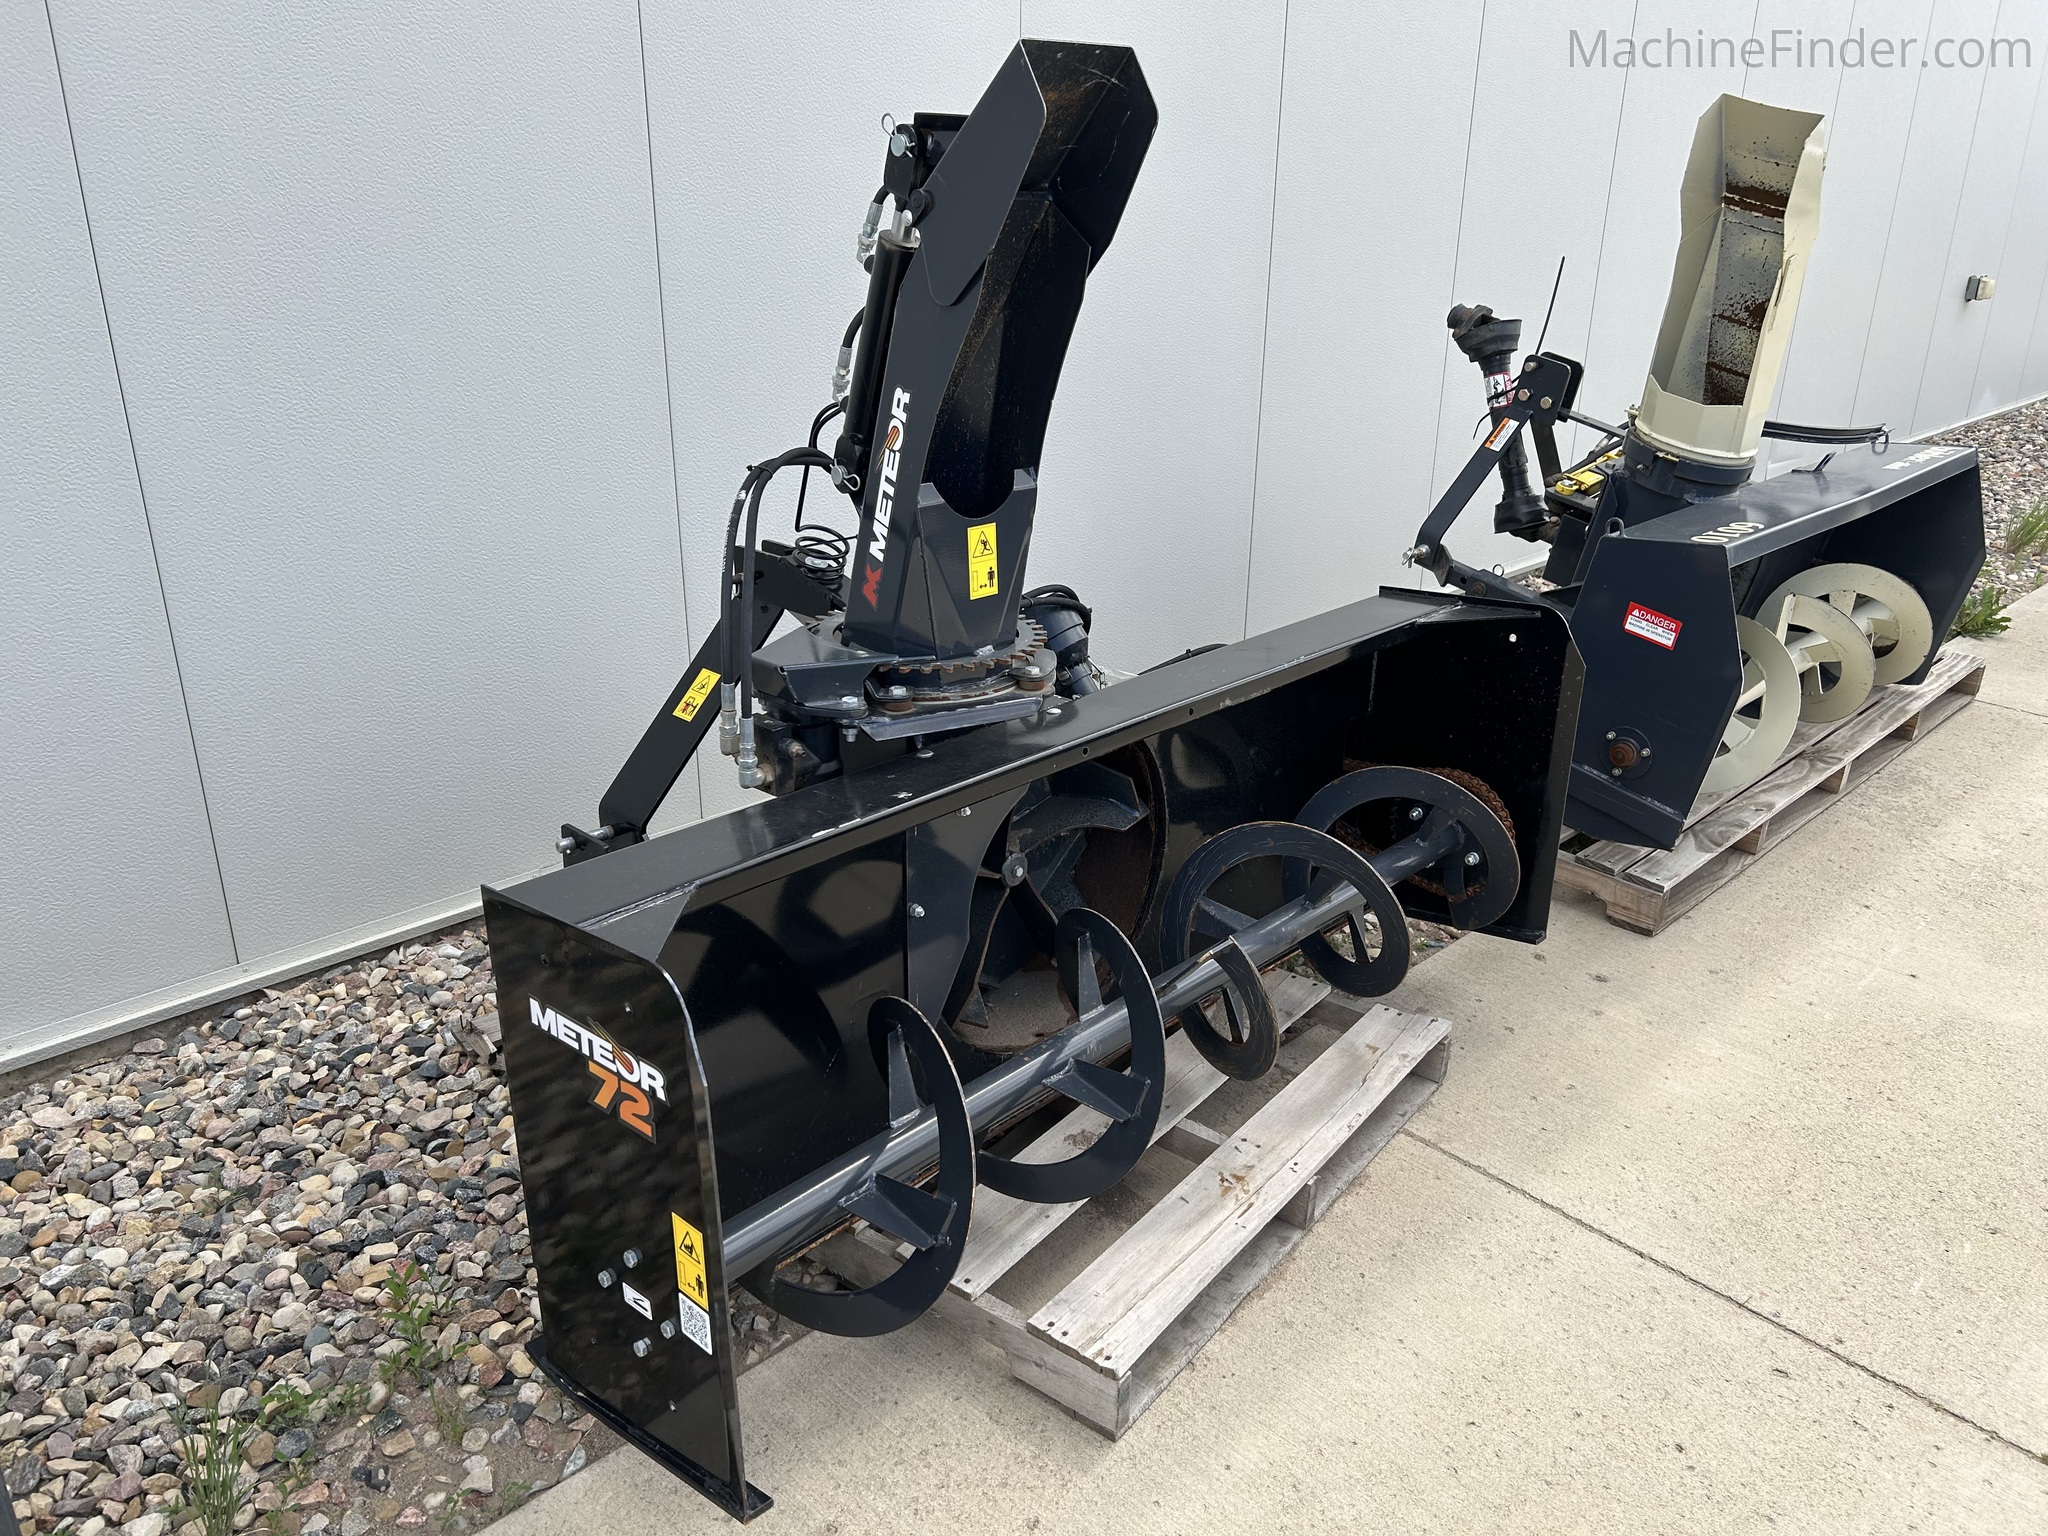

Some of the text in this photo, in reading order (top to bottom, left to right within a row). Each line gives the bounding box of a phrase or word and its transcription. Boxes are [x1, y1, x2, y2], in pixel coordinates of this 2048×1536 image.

[869, 387, 911, 563] METEOR
[1690, 521, 1765, 543] 6010
[1628, 621, 1646, 631] MACHINE
[1650, 629, 1672, 642] OPERATION
[1639, 610, 1676, 631] DANGER
[1645, 622, 1659, 631] CLEAR
[529, 997, 666, 1102] METEOR
[588, 1060, 653, 1138] 72
